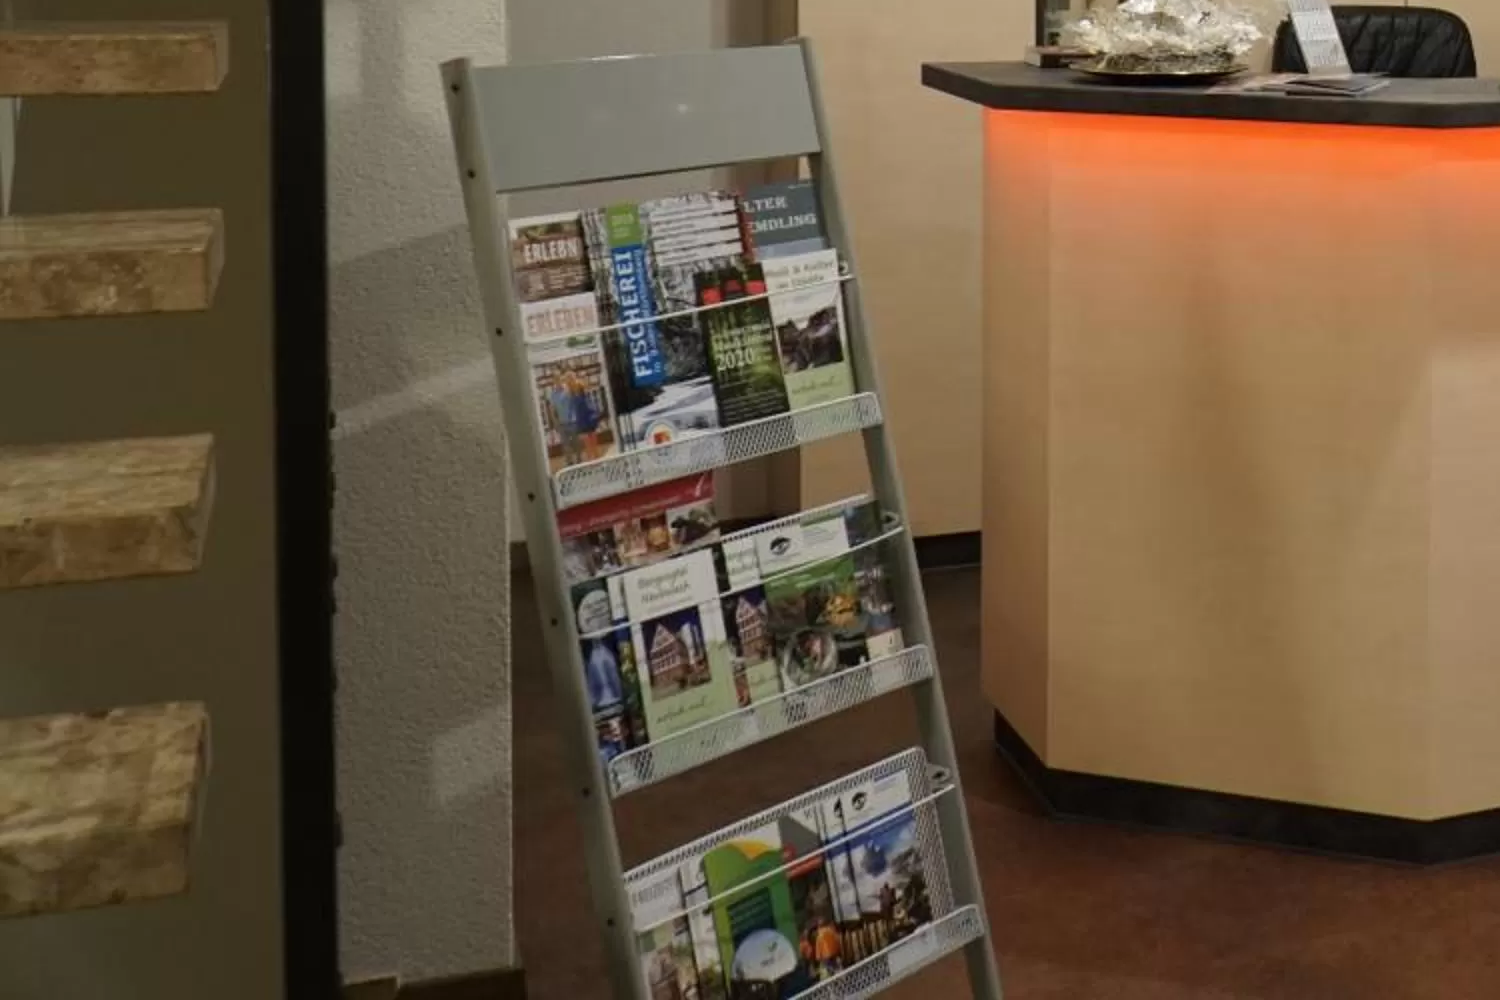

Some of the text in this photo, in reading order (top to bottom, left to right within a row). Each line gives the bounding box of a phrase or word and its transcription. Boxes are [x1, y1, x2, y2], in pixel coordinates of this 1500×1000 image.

[743, 196, 788, 213] LTER
[614, 251, 653, 378] FISCHEREI
[715, 346, 755, 371] 2020
